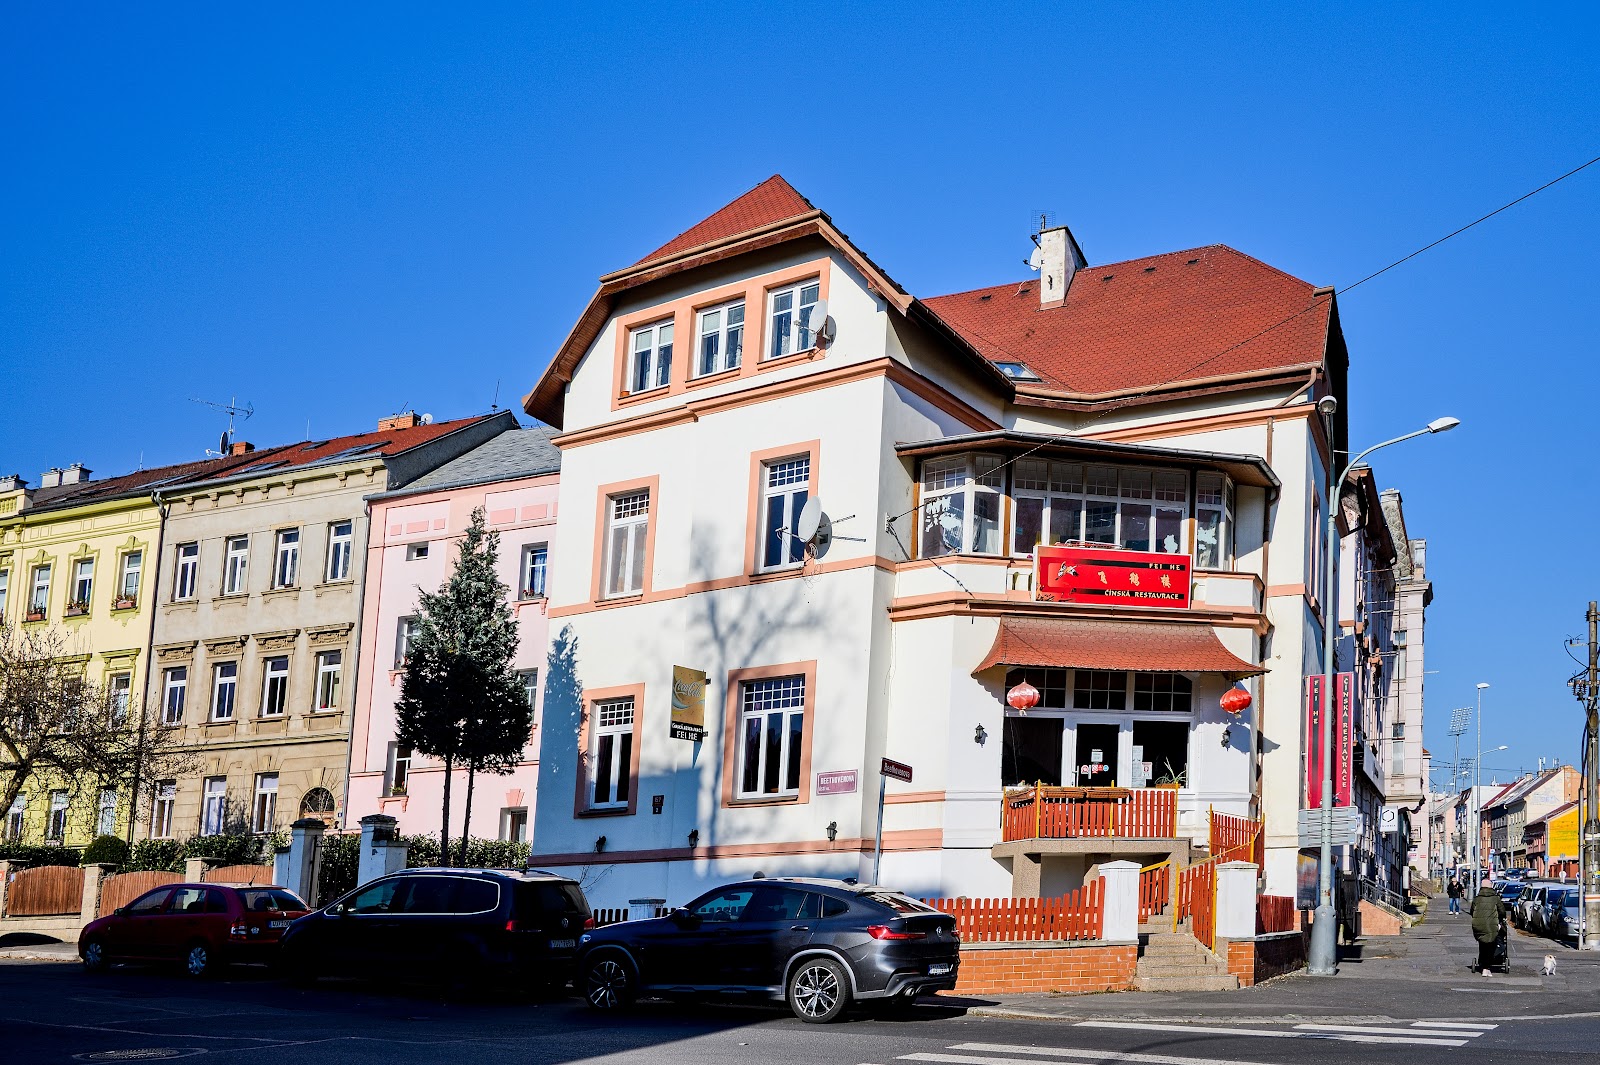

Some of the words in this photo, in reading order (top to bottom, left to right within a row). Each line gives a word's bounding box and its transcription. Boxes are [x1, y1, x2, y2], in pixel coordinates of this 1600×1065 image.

[1104, 588, 1131, 598] ČÍNSKÁ
[1134, 591, 1179, 600] RESTAURACE
[1312, 710, 1319, 725] HE
[676, 730, 687, 739] FEI
[688, 732, 698, 741] HE
[1341, 722, 1349, 788] RESTAURACE
